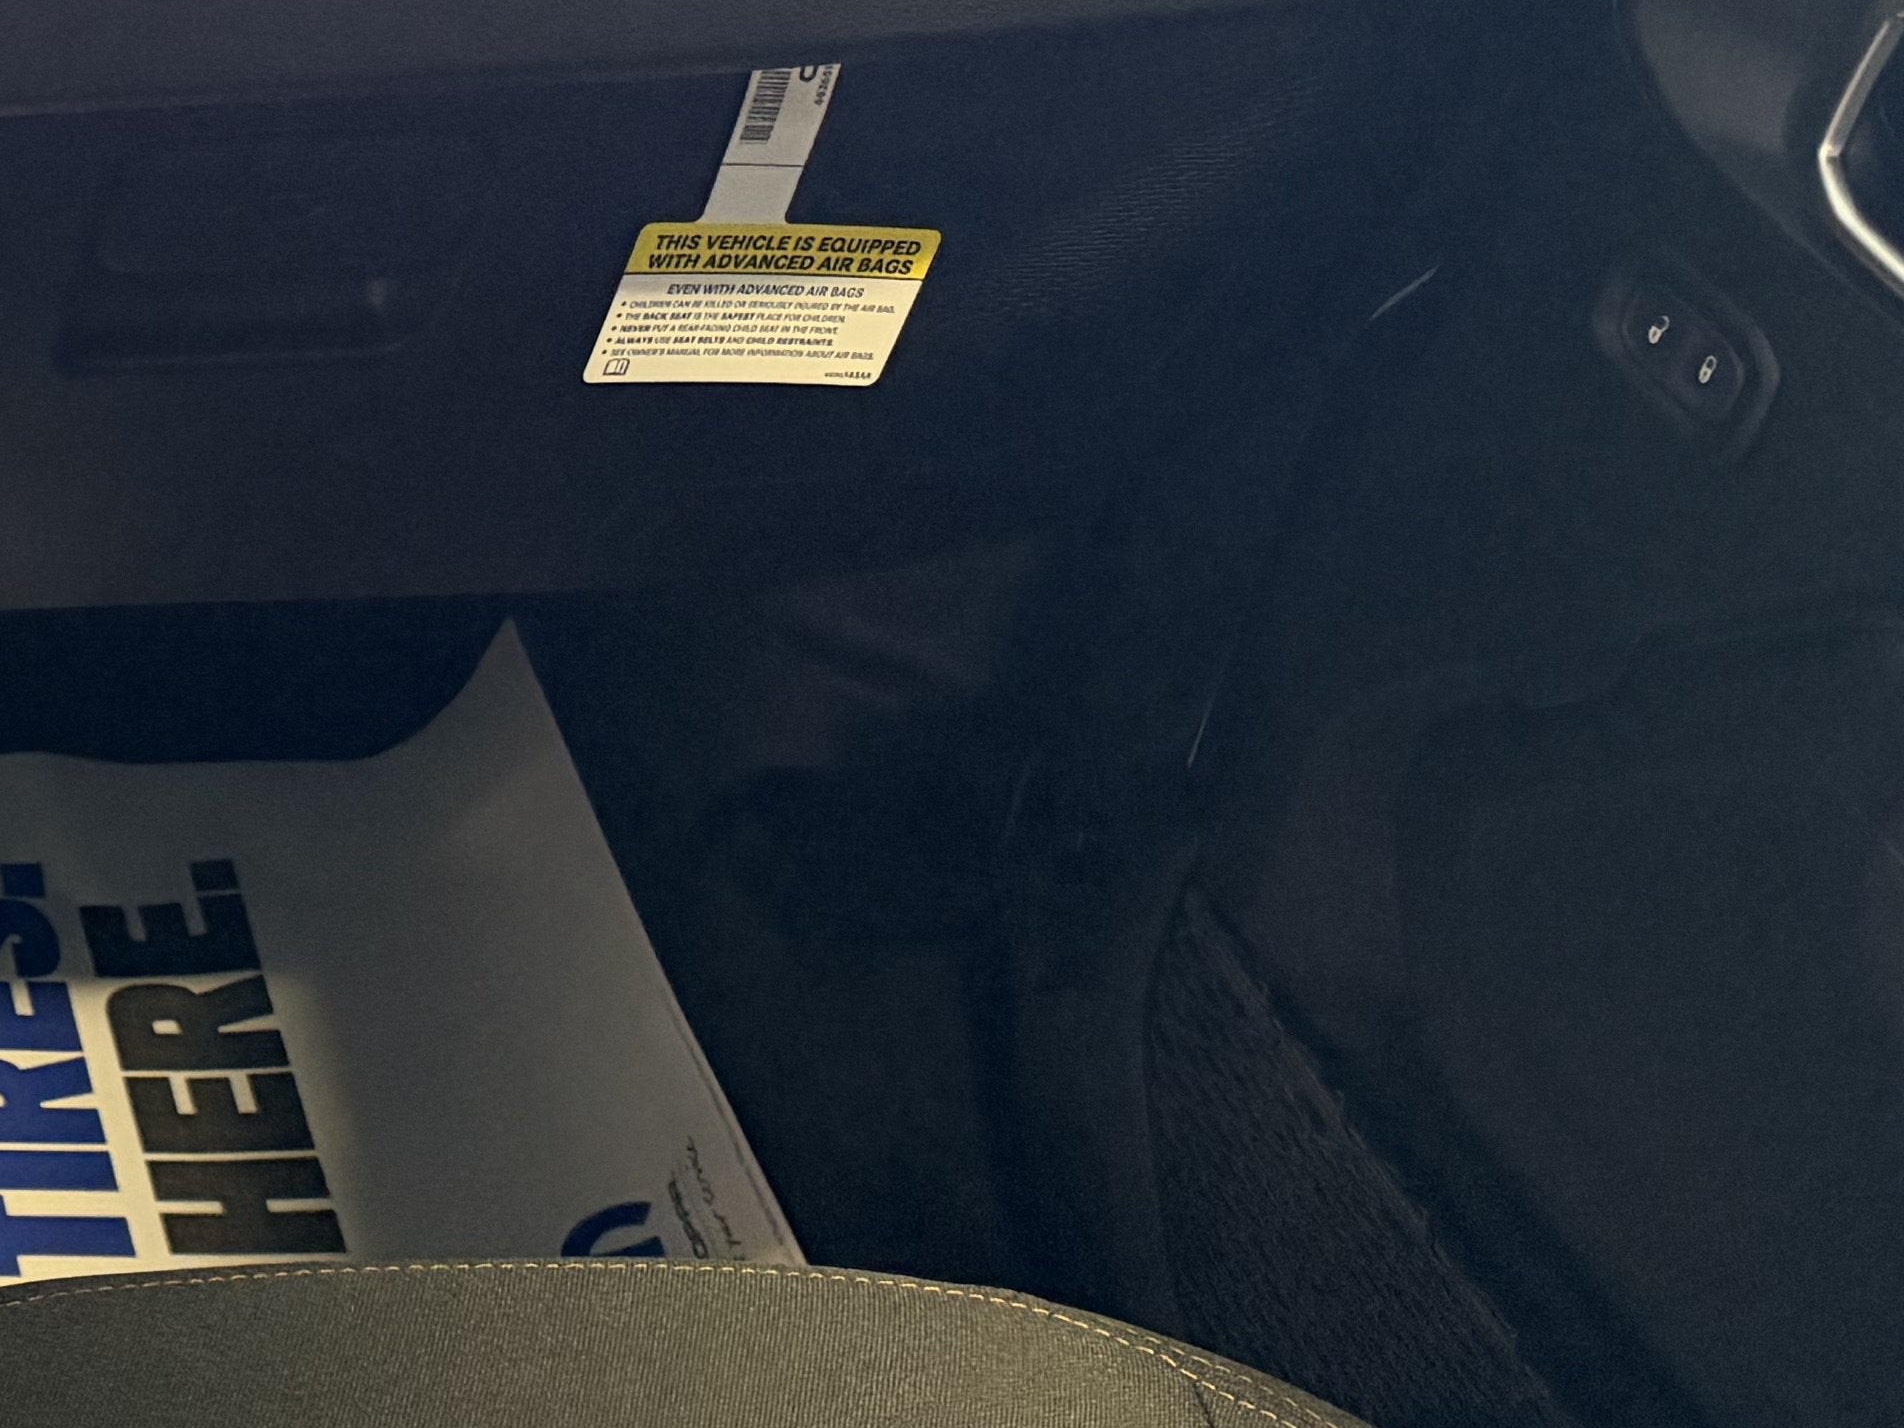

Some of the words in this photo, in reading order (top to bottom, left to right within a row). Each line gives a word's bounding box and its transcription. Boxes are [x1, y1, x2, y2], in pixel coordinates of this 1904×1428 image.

[655, 234, 702, 251] THIS
[706, 235, 791, 253] VEHICLE
[794, 236, 815, 253] IS
[818, 237, 922, 257] EQUIPPED
[648, 253, 700, 269] WITH
[702, 254, 815, 272] ADVANCED
[817, 256, 854, 273] AIR
[856, 258, 914, 276] BAGS
[667, 284, 700, 296] EVEN
[703, 284, 735, 297] WITH
[736, 284, 805, 297] ADVANCED
[806, 286, 829, 297] AIR
[830, 287, 865, 299] BAGS
[78, 858, 348, 1255] HERE.
